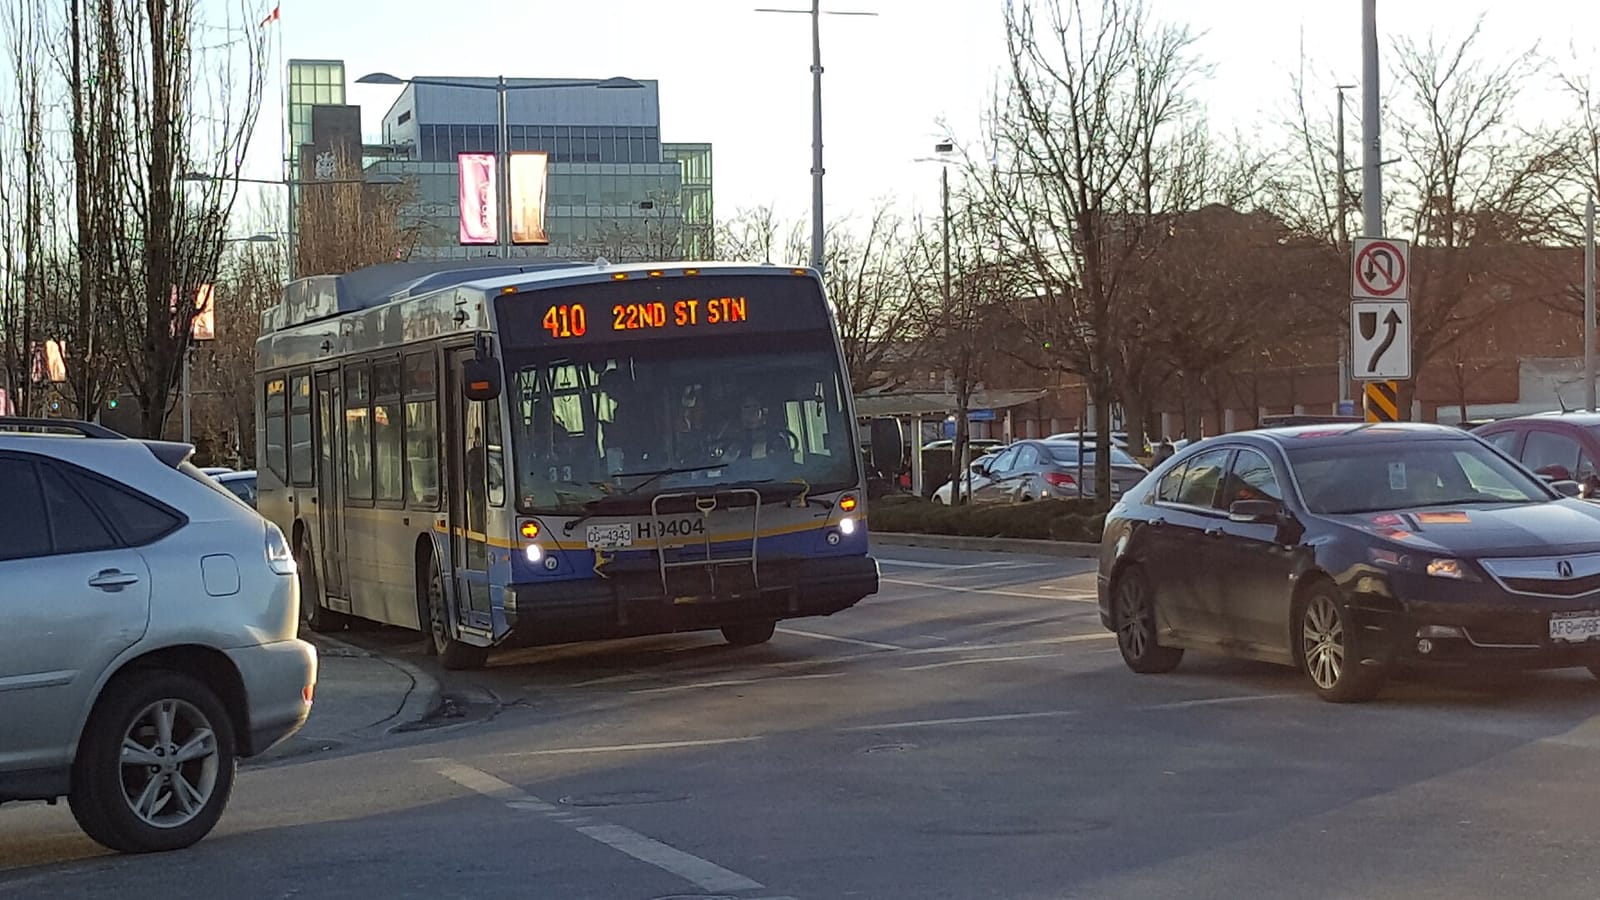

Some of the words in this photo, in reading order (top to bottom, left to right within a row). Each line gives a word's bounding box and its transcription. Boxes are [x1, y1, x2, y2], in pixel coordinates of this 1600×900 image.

[542, 303, 586, 337] 410
[612, 301, 666, 330] 22ND
[674, 299, 699, 325] ST
[706, 297, 747, 323] STN
